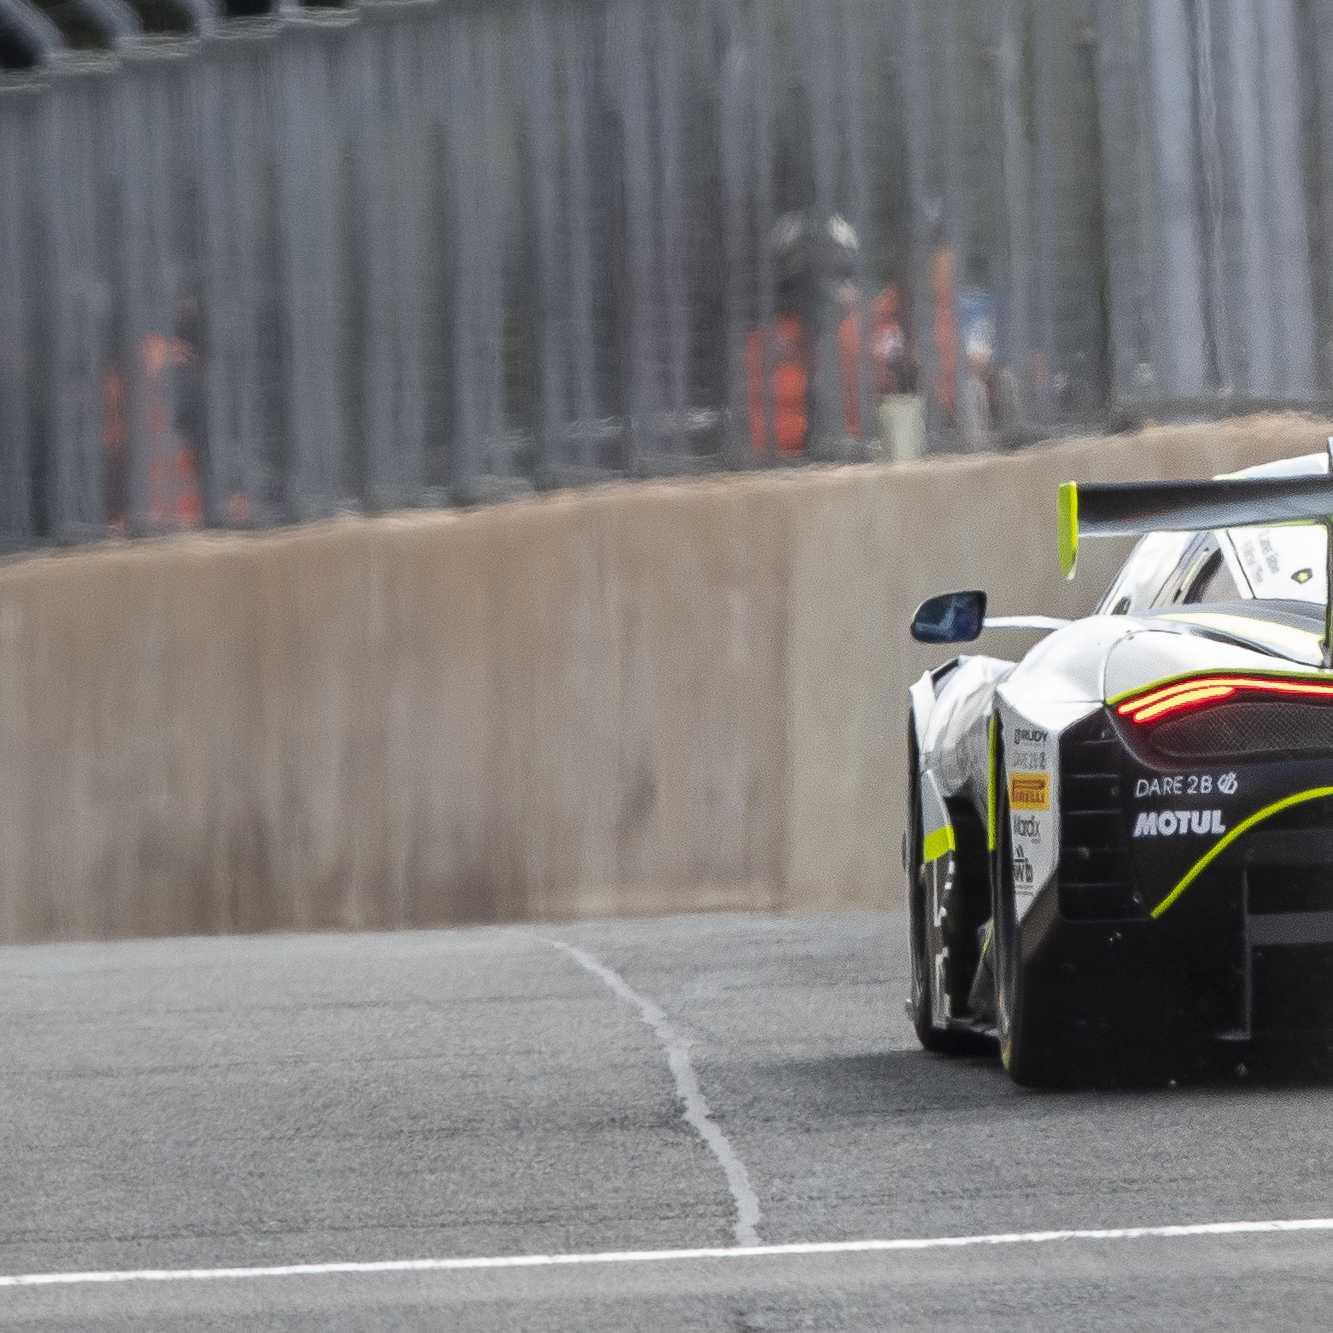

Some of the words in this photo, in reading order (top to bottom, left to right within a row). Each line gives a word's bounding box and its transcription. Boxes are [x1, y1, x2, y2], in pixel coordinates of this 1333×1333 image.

[1135, 775, 1184, 798] DARE
[1186, 774, 1213, 795] 2B
[1132, 809, 1227, 838] MOTUL
